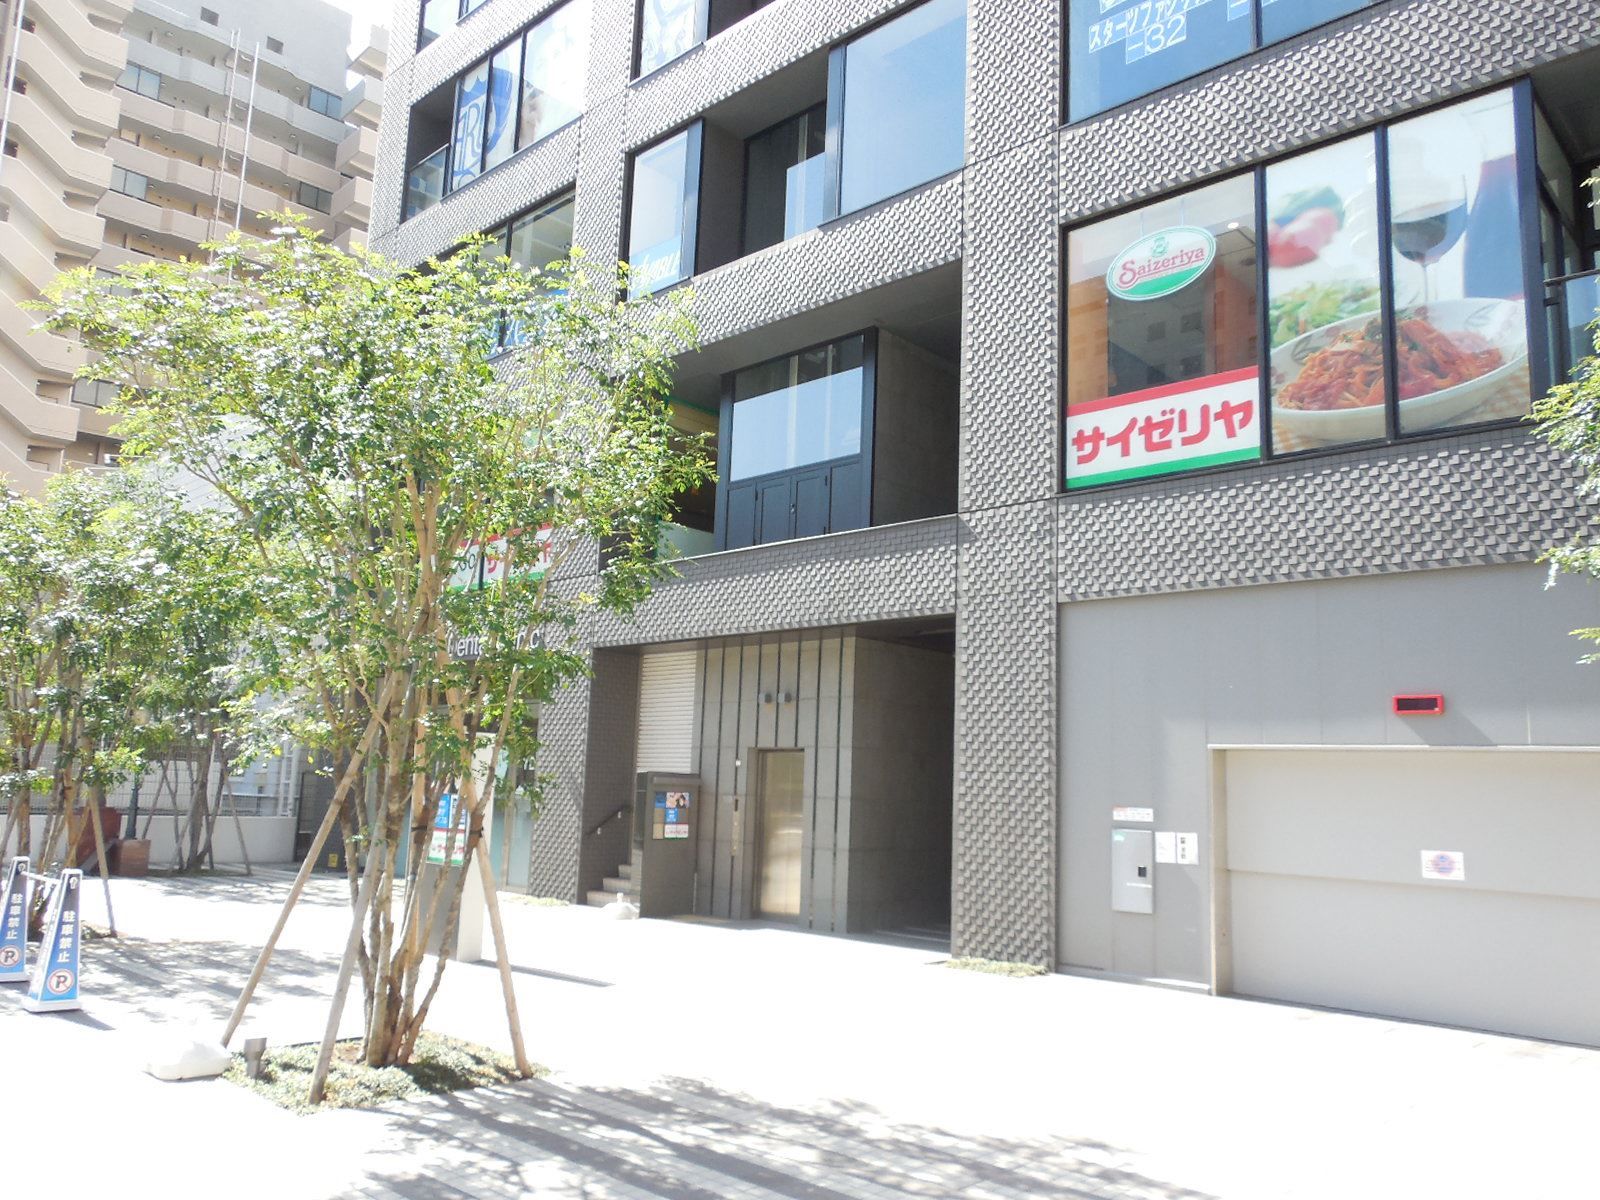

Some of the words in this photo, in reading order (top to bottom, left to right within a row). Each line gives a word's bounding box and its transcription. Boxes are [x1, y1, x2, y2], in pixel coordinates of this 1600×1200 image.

[1116, 245, 1205, 290] Saizeriya
[1071, 399, 1254, 465] サイゼリヤ
[5, 893, 23, 940] 駐車禁止
[56, 911, 76, 963] 駐車禁止
